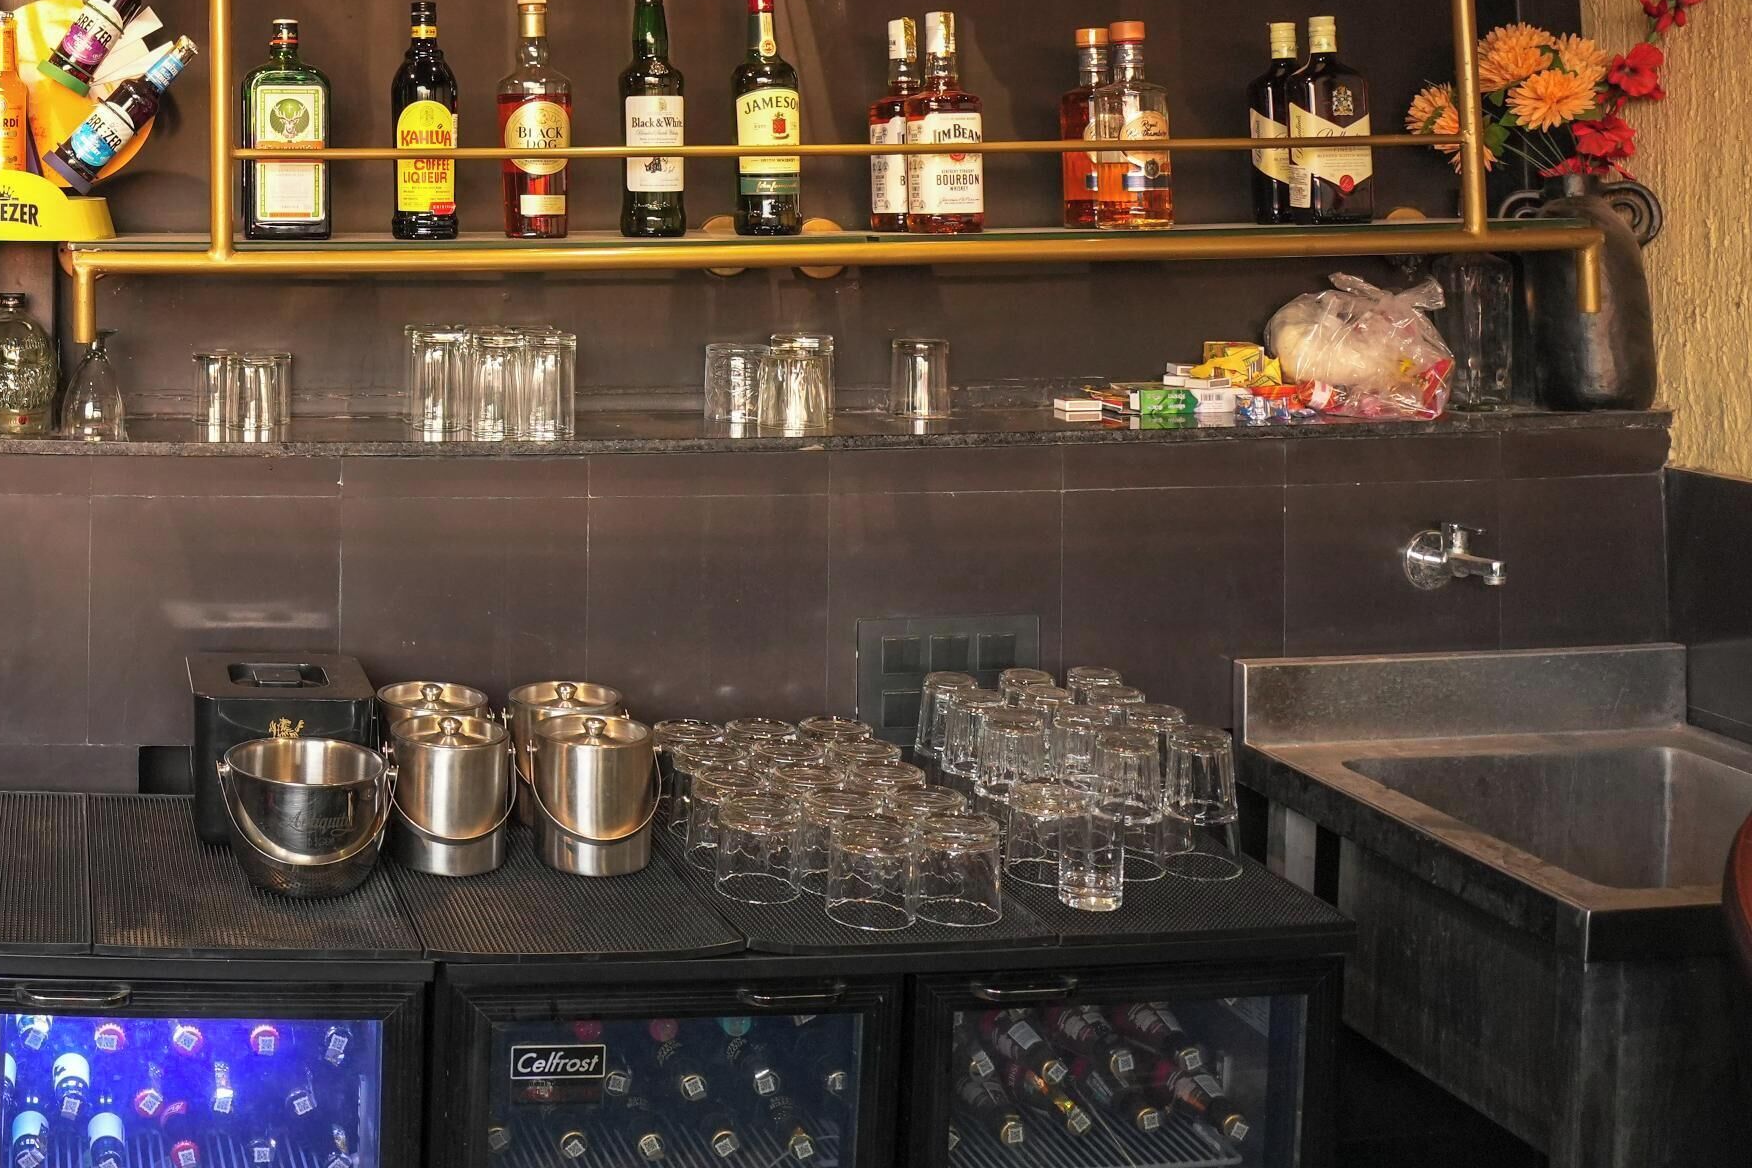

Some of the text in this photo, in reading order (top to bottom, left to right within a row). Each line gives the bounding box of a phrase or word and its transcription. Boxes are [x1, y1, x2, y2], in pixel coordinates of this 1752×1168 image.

[631, 116, 655, 129] Black
[414, 158, 450, 171] COFFEE
[403, 171, 448, 185] LIQUEUR
[936, 173, 980, 186] BOURBON
[516, 1051, 600, 1074] Celfrost
